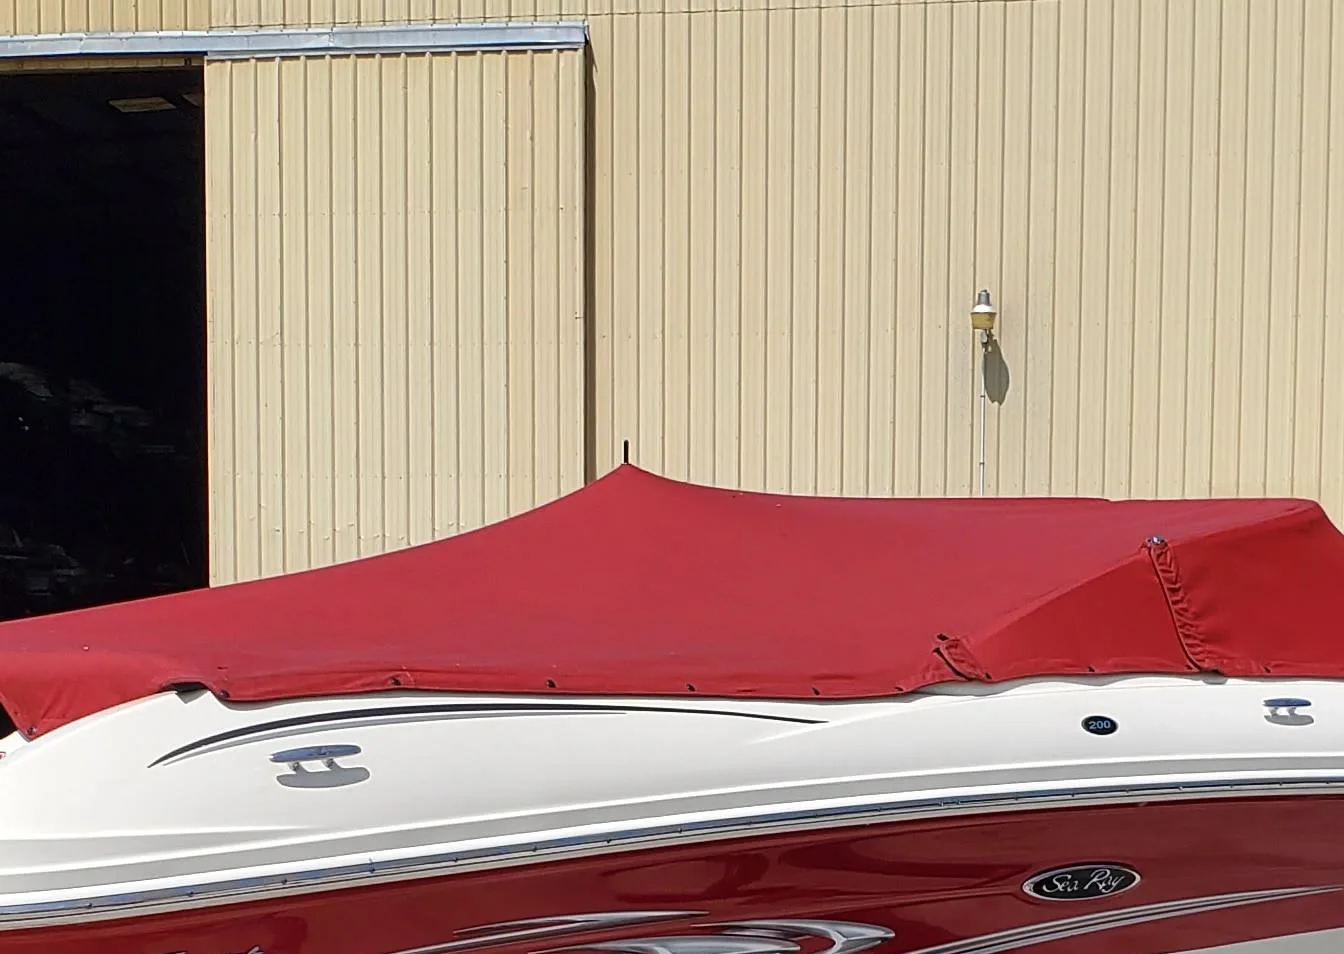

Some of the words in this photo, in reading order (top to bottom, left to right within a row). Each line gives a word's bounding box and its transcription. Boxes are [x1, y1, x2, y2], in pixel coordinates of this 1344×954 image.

[1088, 720, 1111, 729] 200
[1042, 874, 1079, 893] Sea
[1083, 868, 1125, 893] Ray
